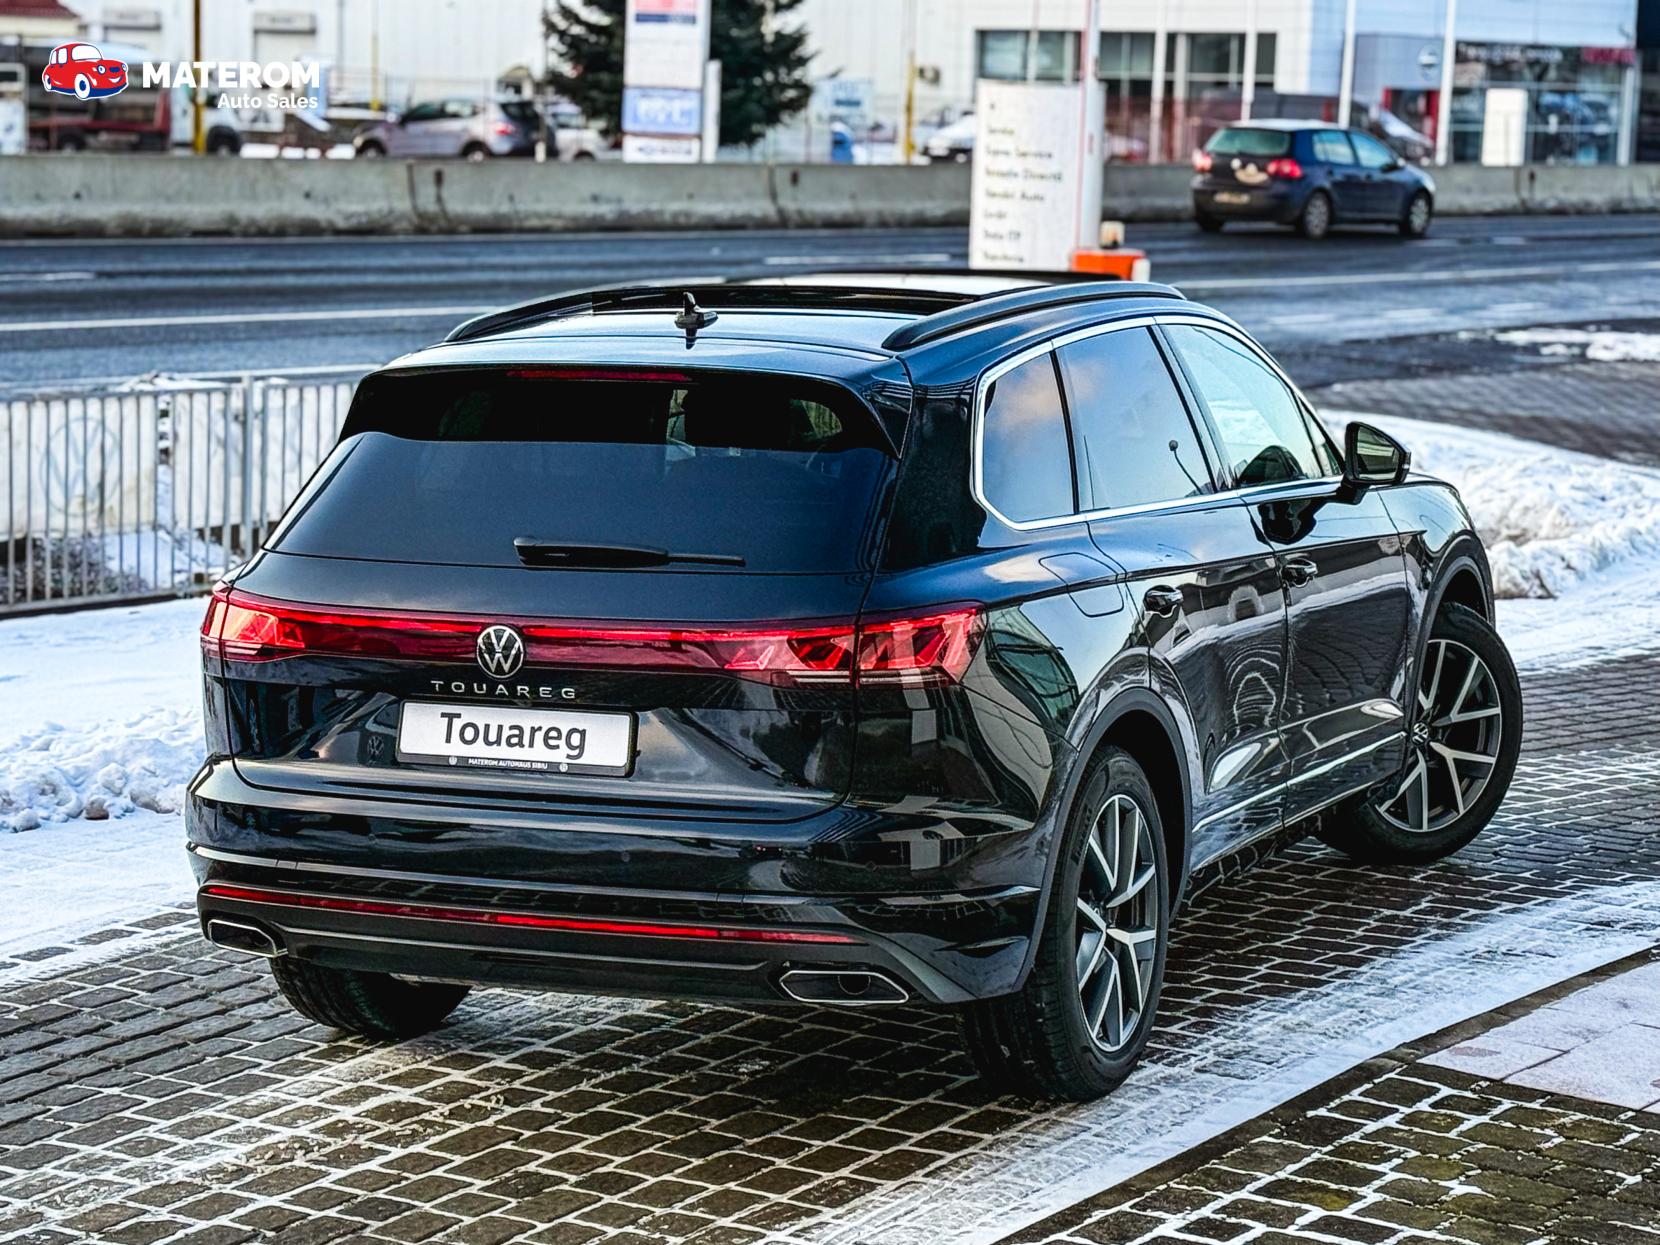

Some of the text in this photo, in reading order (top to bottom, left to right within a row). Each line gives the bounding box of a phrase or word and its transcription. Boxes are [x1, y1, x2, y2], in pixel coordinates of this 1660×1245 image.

[431, 680, 576, 699] TOUAREG
[440, 711, 587, 760] Touareg
[498, 760, 531, 768] AUTOHAUS
